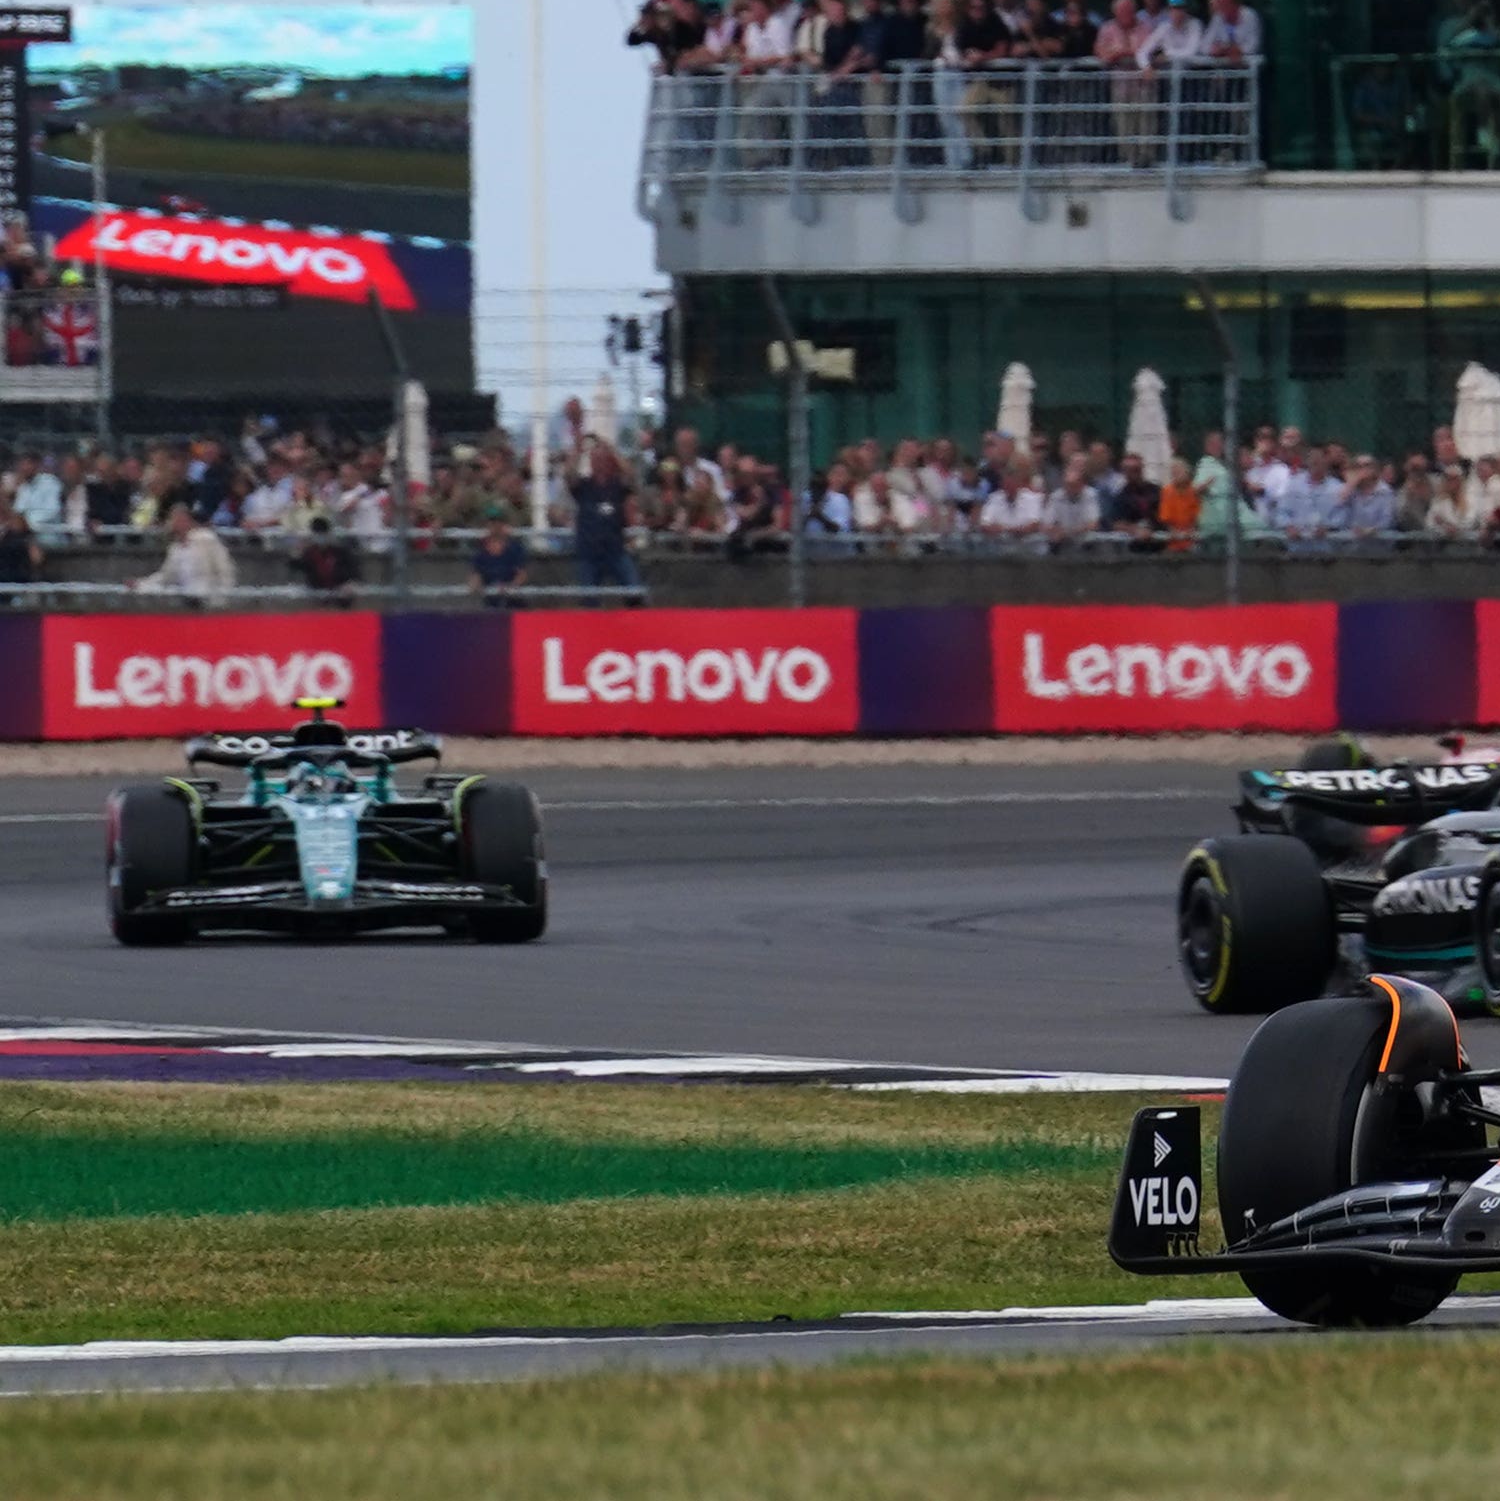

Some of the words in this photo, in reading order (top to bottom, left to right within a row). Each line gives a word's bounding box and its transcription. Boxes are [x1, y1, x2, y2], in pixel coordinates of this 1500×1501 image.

[90, 218, 366, 284] Lenovo
[76, 642, 352, 707] Lenovo
[543, 637, 830, 702] Lenovo
[1023, 633, 1311, 699] Lenovo
[1128, 1175, 1199, 1228] VELO
